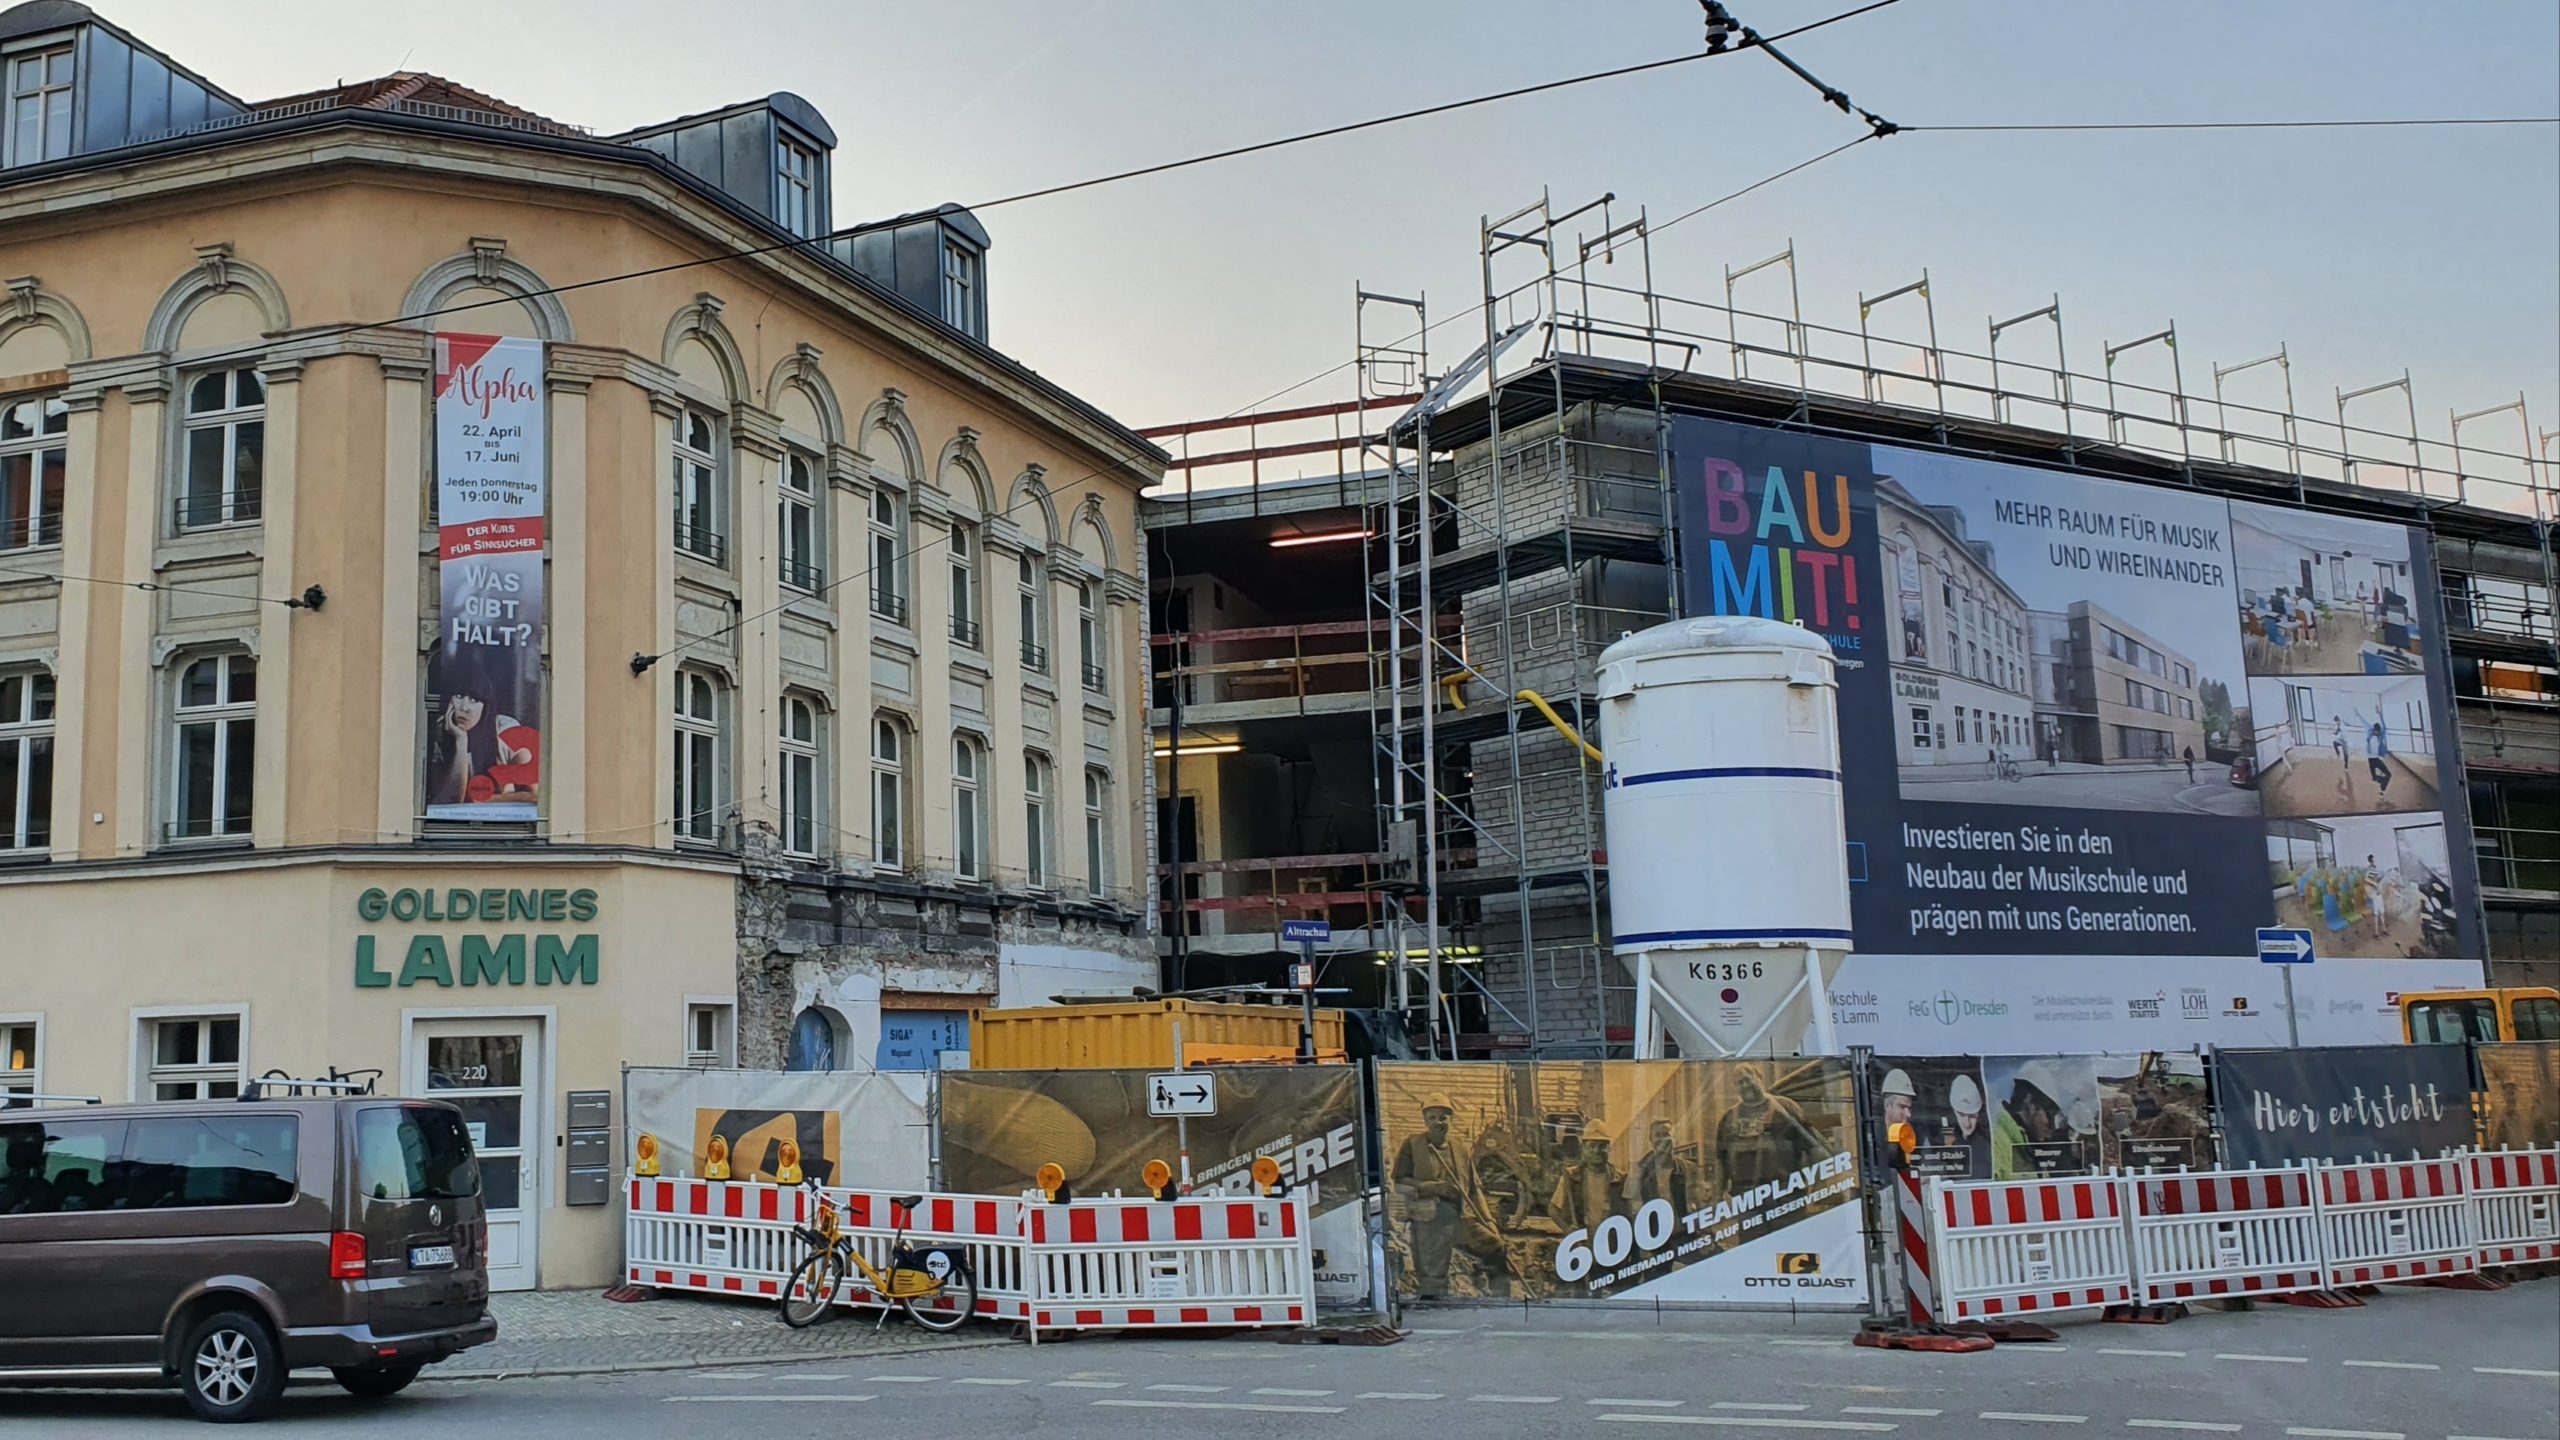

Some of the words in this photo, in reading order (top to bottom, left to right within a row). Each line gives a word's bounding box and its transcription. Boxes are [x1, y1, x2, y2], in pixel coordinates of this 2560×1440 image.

[446, 364, 537, 419] Alpha
[462, 425, 484, 437] 22.
[489, 426, 521, 439] April
[465, 451, 486, 462] 17.
[491, 451, 520, 464] Juni
[445, 477, 478, 487] Jeden
[481, 478, 537, 493] Donnerstag
[460, 490, 500, 503] 19:00
[503, 491, 524, 505] Uhr
[1704, 456, 1851, 548] BAU
[467, 526, 488, 537] DER
[490, 523, 516, 534] KURS
[1995, 499, 2053, 529] MEHR
[2058, 508, 2115, 537] RAUM
[2120, 513, 2157, 543] FÜR
[2162, 522, 2221, 552] MUSIK
[450, 543, 472, 555] FÜR
[463, 563, 520, 592] WAS
[2050, 543, 2091, 570] UND
[2097, 549, 2224, 588] WIREINANDER
[1710, 539, 1860, 629] MIT!
[465, 595, 519, 620] GIBT
[452, 617, 532, 647] HALT?
[1896, 683, 1940, 701] LAMM
[1902, 822, 2015, 851] Investieren
[2020, 826, 2051, 852] Sie
[2054, 827, 2074, 853] in
[2078, 828, 2113, 854] den
[1906, 862, 1986, 890] Neubau
[1992, 864, 2023, 891] der
[2028, 865, 2148, 894] Musikschule
[2152, 869, 2188, 896] und
[358, 887, 599, 922] GOLDENES
[1286, 926, 1328, 938] Alttrachau
[1910, 903, 1983, 937] prägen
[1988, 904, 2020, 931] mit
[2026, 908, 2061, 931] uns
[2067, 905, 2197, 933] Generationen.
[355, 934, 599, 988] LAMM
[1828, 990, 1878, 1006] ikschule
[1909, 999, 1930, 1016] FeG
[1964, 998, 2008, 1016] Dresden
[2128, 999, 2159, 1009] WERTE
[2181, 995, 2208, 1010] LOH
[1842, 1010, 1880, 1024] Lamm
[461, 1064, 487, 1081] 220
[2253, 1089, 2320, 1133] Hier
[2329, 1083, 2444, 1129] entsteht
[1197, 1151, 1251, 1183] BRINGEN
[1255, 1134, 1293, 1158] DEINE
[1555, 1198, 1675, 1282] 600
[1682, 1151, 1852, 1234] TEAMPLAYER
[1589, 1273, 1614, 1290] UND
[1618, 1250, 1674, 1279] NIEMAND
[1677, 1235, 1712, 1256] MUSS
[1714, 1224, 1740, 1242] AUF
[1743, 1215, 1763, 1231] DIE
[1765, 1175, 1856, 1221] RESERVEBANK
[1744, 1277, 1791, 1288] OTTO
[1797, 1277, 1856, 1288] QUAST
